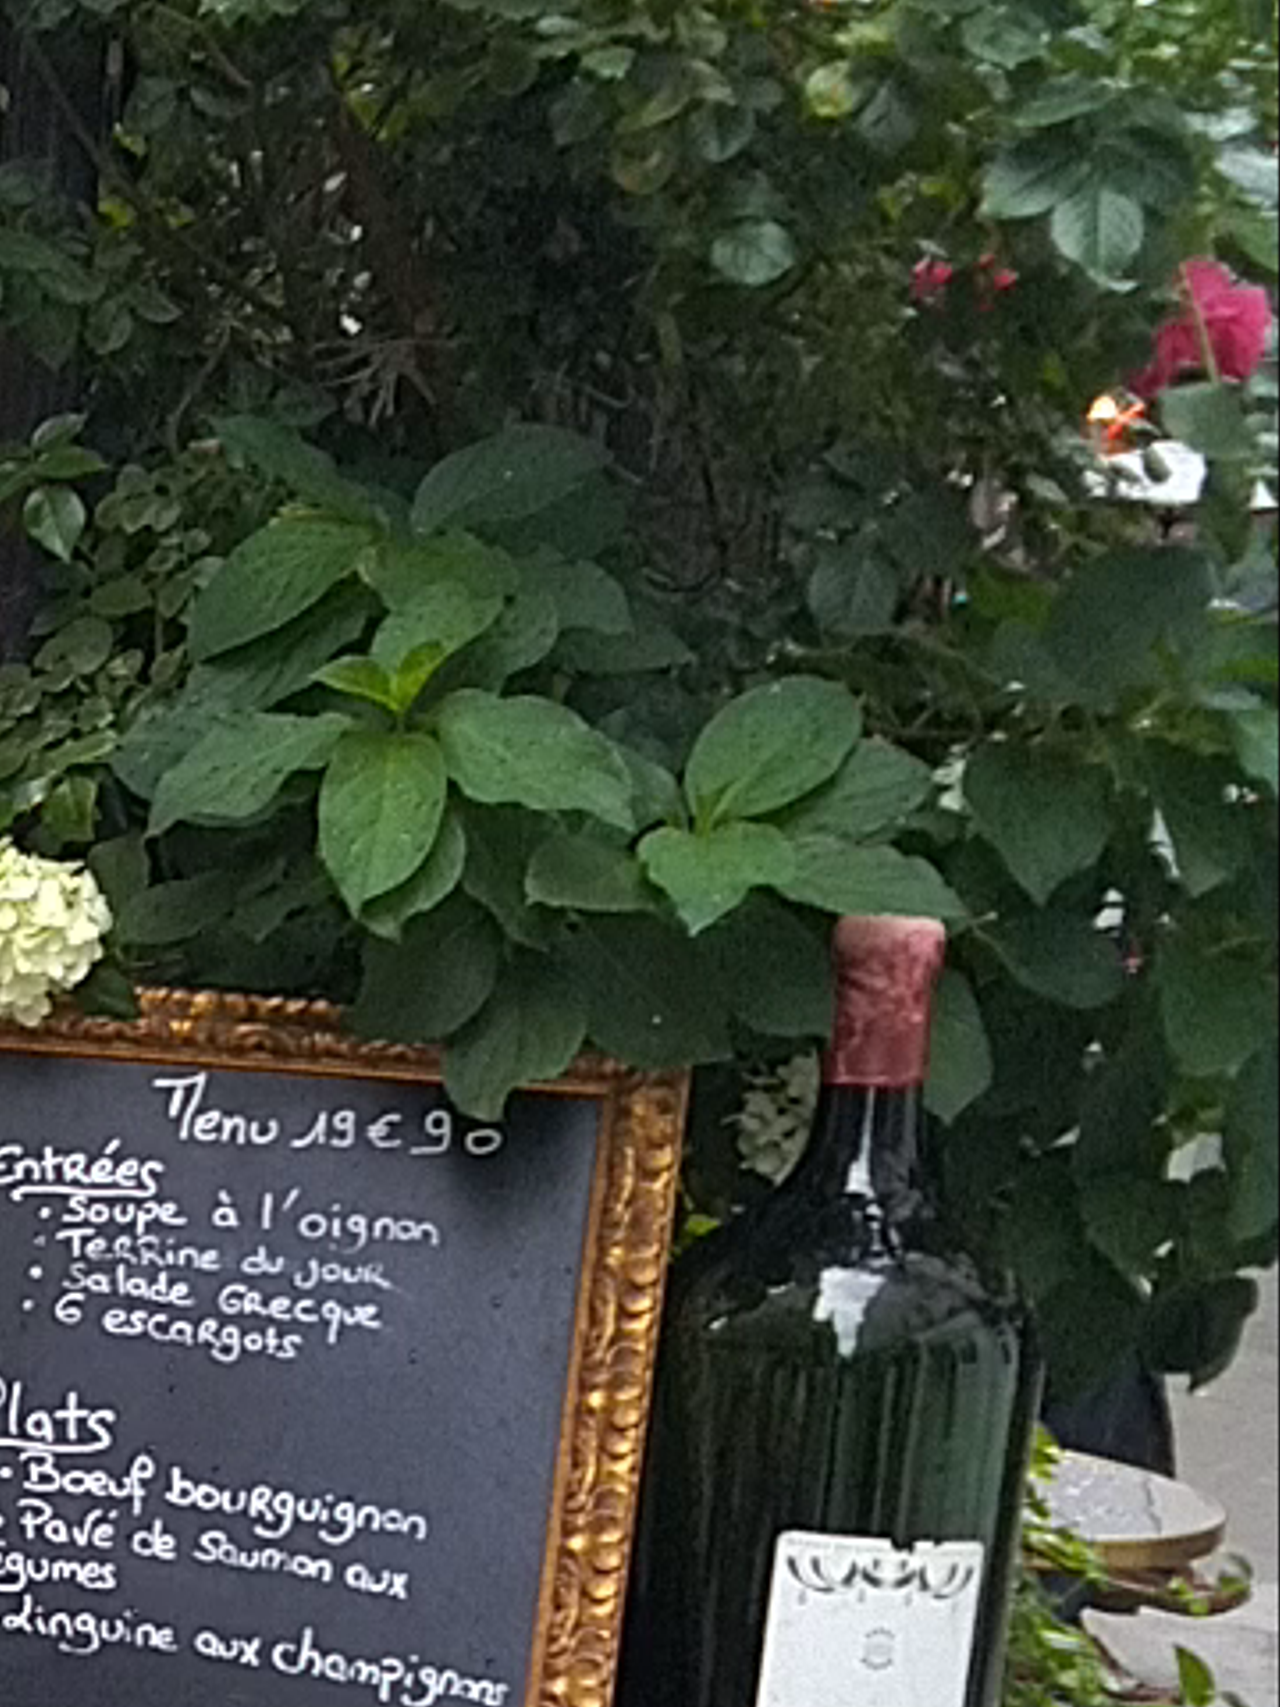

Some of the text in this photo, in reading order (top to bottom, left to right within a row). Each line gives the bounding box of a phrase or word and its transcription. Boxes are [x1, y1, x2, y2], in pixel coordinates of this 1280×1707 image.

[153, 1071, 279, 1141] Menu
[61, 1188, 439, 1255] Soupe à l'oignon
[240, 1246, 285, 1276] du
[53, 1293, 82, 1324] 6
[62, 1262, 194, 1309] Salade
[16, 1498, 119, 1550] Pavé
[132, 1521, 177, 1561] de
[345, 1563, 409, 1599] aux
[194, 1629, 261, 1667] aux
